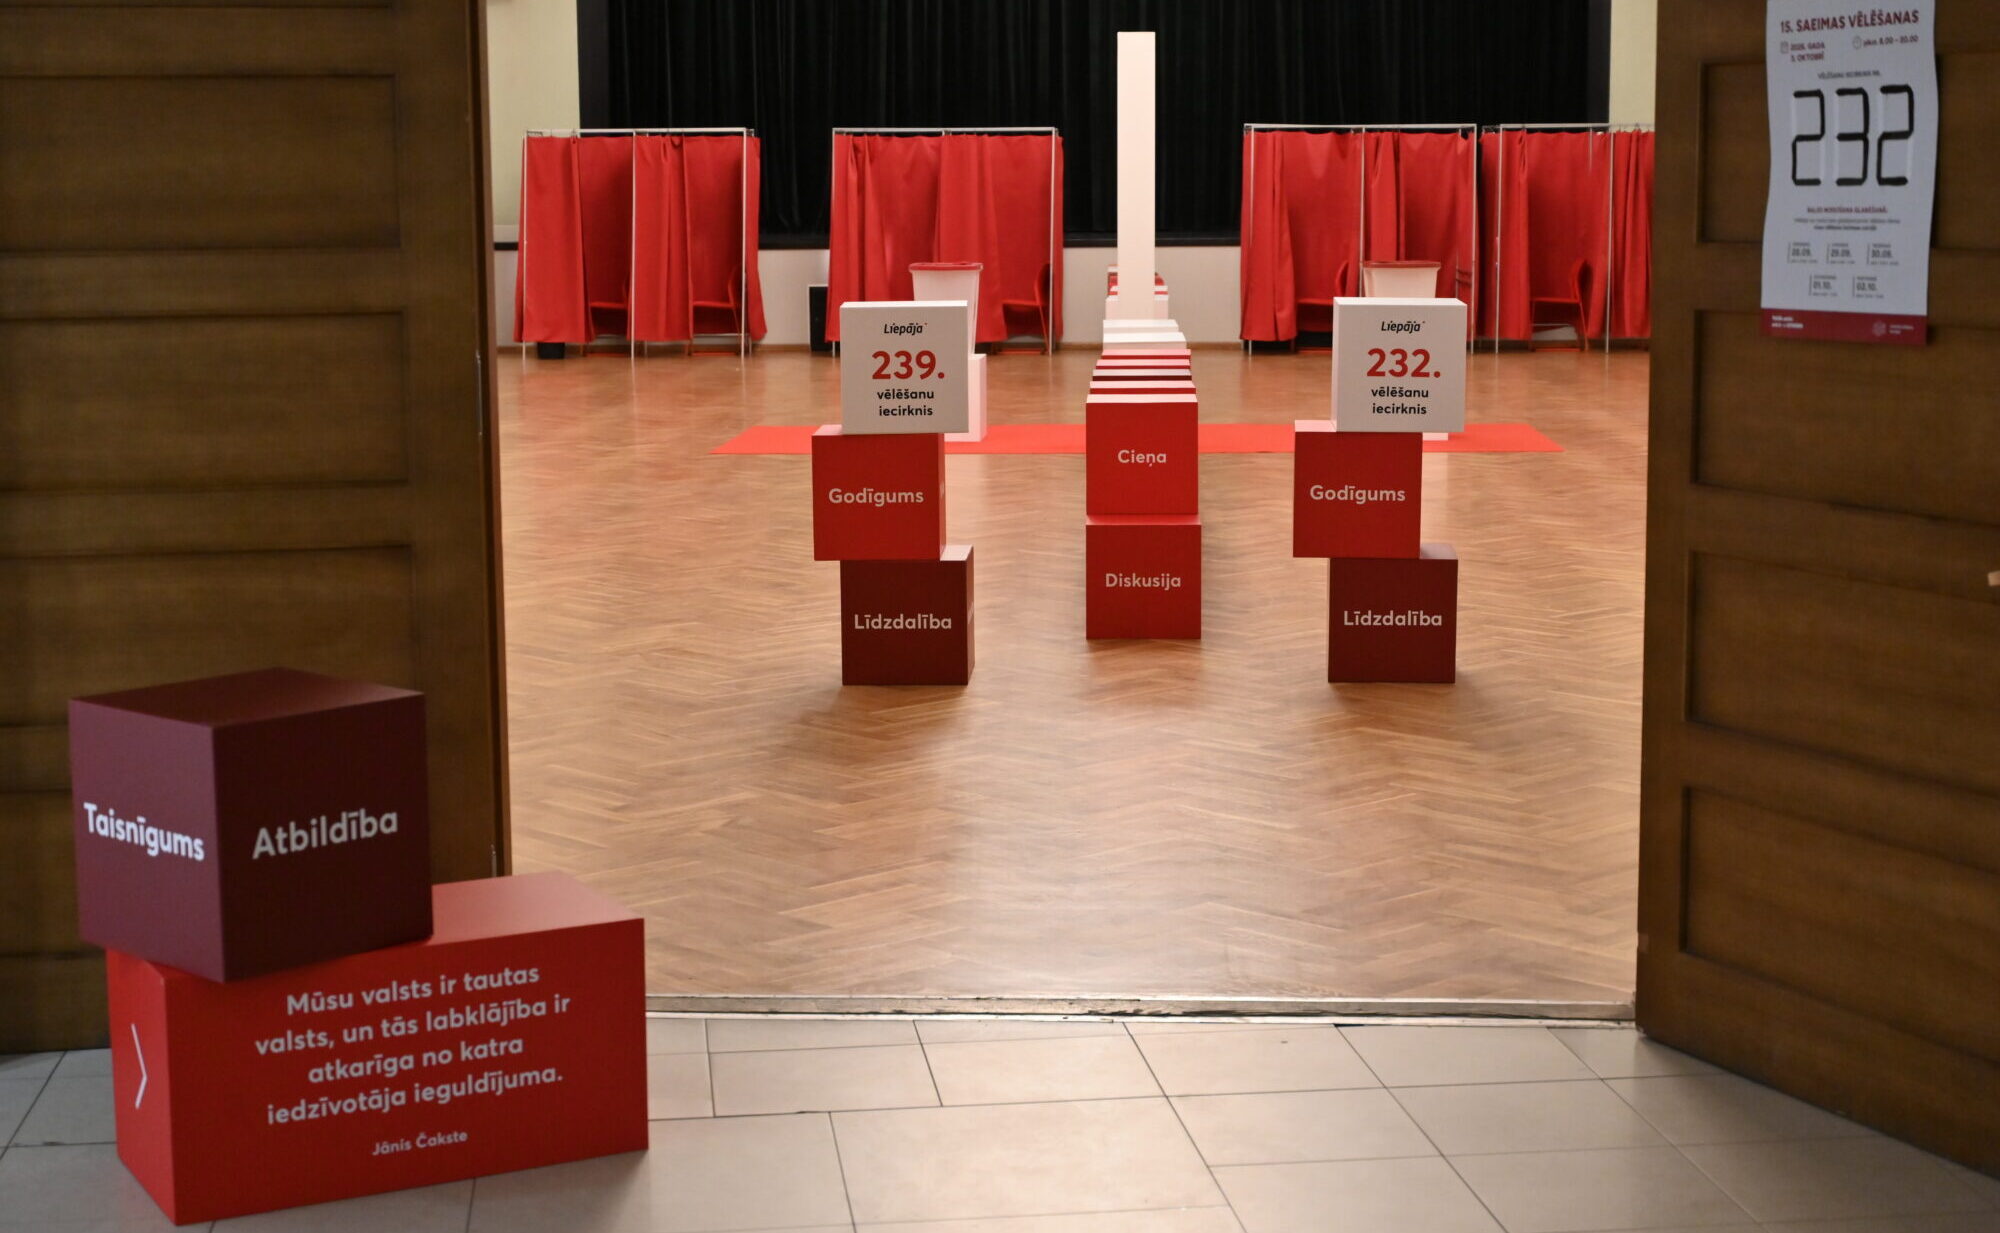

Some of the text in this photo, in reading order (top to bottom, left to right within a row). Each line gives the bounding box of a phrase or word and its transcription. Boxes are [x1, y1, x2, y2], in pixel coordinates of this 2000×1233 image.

[1781, 9, 1920, 33] 15. SAEIMAS VĒLĒŠANAS
[1792, 84, 1914, 187] 232
[884, 322, 923, 336] Liepāja
[1381, 320, 1421, 334] Liepāja
[872, 350, 945, 380] 239.
[1366, 348, 1441, 378] 232.
[877, 388, 934, 400] vēlēšanu
[1371, 386, 1429, 398] vēlēšanu
[879, 405, 933, 416] iecirknis
[1372, 403, 1427, 415] iecirknis
[1117, 449, 1167, 468] Cieņa
[828, 486, 924, 508] Godīgums
[1309, 484, 1406, 505] Godīgums
[1105, 572, 1182, 591] Diskusija
[854, 613, 953, 631] Līdzdalība
[1343, 610, 1443, 628] Līdzdalība
[84, 802, 205, 861] Taisnīgums
[252, 808, 399, 860] Atbildība
[286, 967, 540, 1016] Mūsu valsts ir tautas
[255, 994, 571, 1056] valsts, un tās labklājība ir
[308, 1037, 524, 1084] atkarīga no katra
[267, 1065, 563, 1125] iedzīvotāja ieguldījuma.
[372, 1130, 468, 1156] Jānis Čakste
